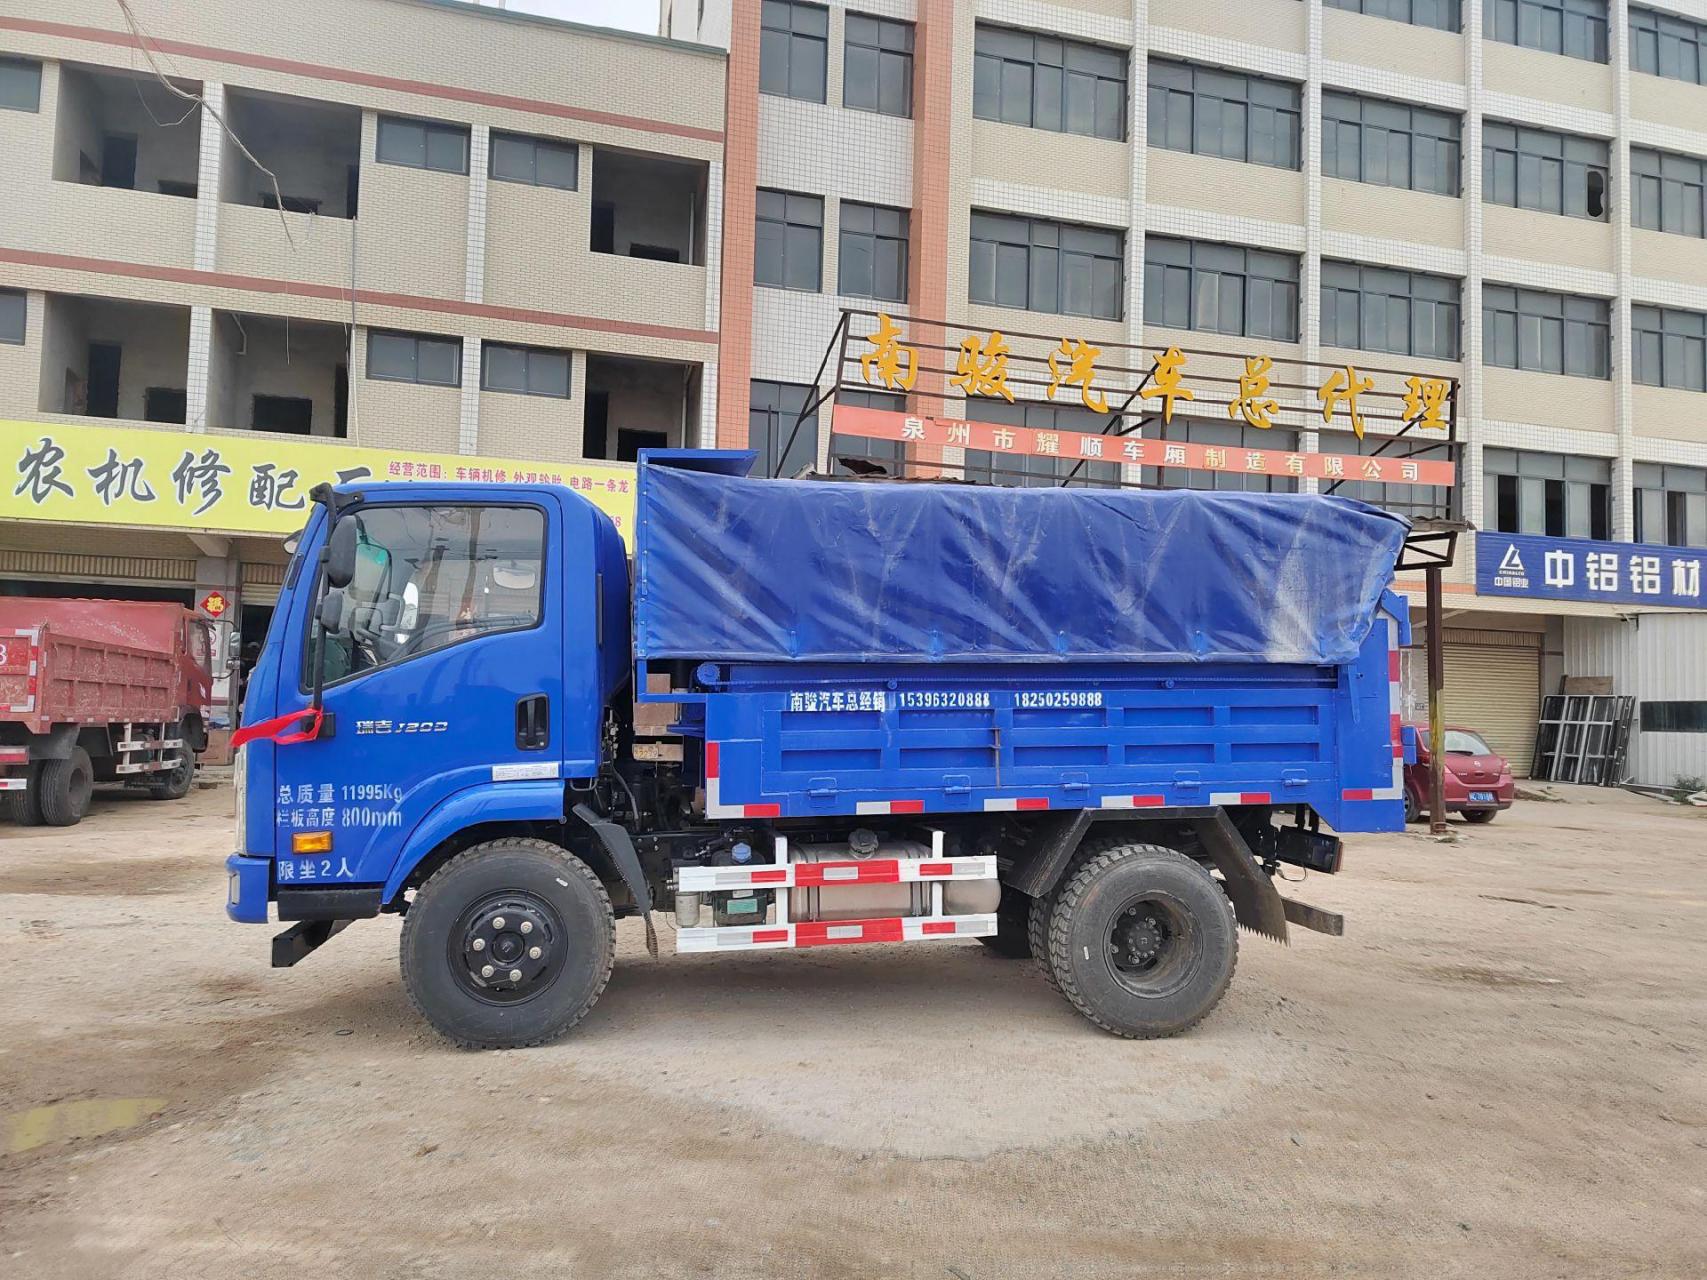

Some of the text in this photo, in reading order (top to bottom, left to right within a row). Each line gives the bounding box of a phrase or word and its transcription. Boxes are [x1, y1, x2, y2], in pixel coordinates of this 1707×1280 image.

[861, 313, 1449, 440] 南骏汽车总代理
[902, 417, 1419, 481] 泉州市耀顺车厢制造有限公司
[569, 475, 629, 493] 电路一条龙
[1544, 549, 1700, 597] 中铝铝材
[790, 691, 1103, 712] 南骏汽车总经销 15396320888 18250259888
[277, 783, 335, 804] 总质量
[341, 806, 402, 828] 800mm
